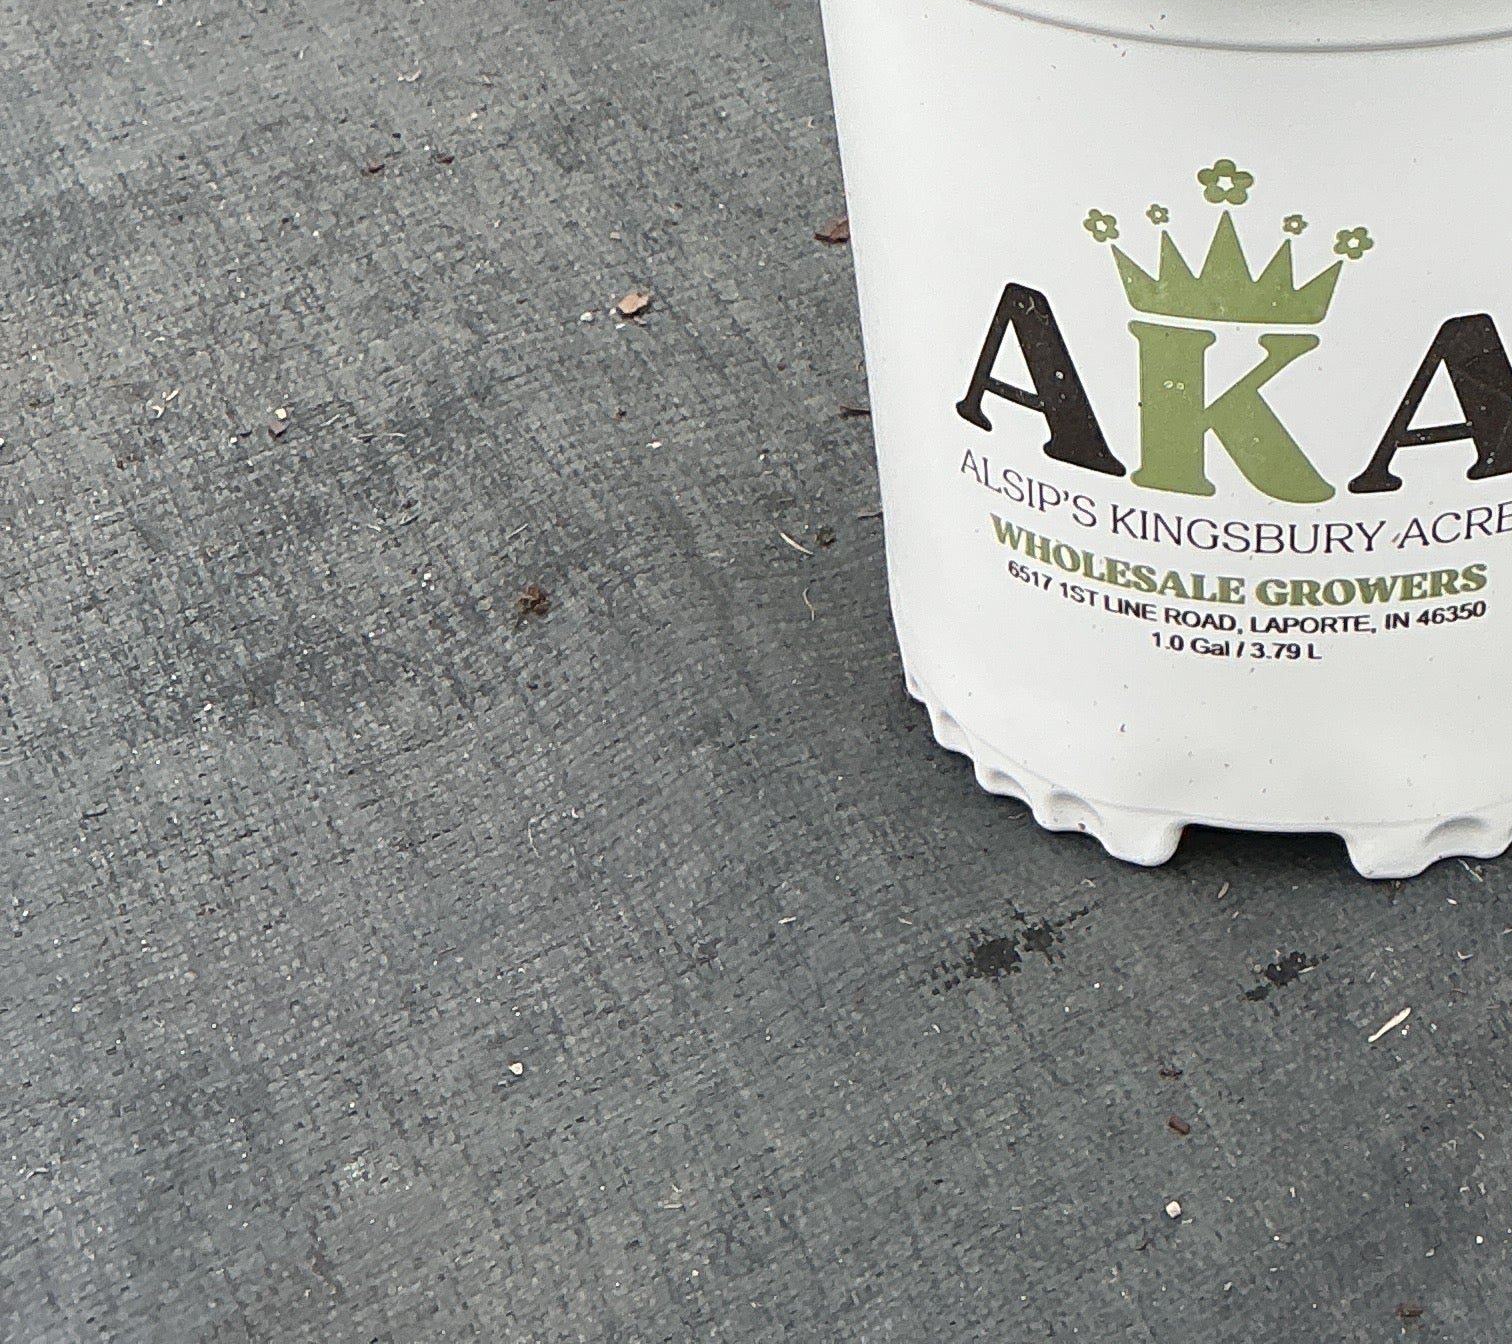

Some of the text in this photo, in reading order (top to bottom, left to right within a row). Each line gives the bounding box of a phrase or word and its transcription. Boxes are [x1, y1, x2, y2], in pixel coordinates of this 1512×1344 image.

[961, 448, 1097, 527] ALSIP'S
[1111, 504, 1386, 554] KINGSBURY
[989, 513, 1488, 606] WHOLESALE GROWERS
[1008, 560, 1486, 634] 6517 1ST LINE ROAD, LAPORTE, IN 46350
[1152, 632, 1321, 662] 1.0 Gal / 3.79 L
